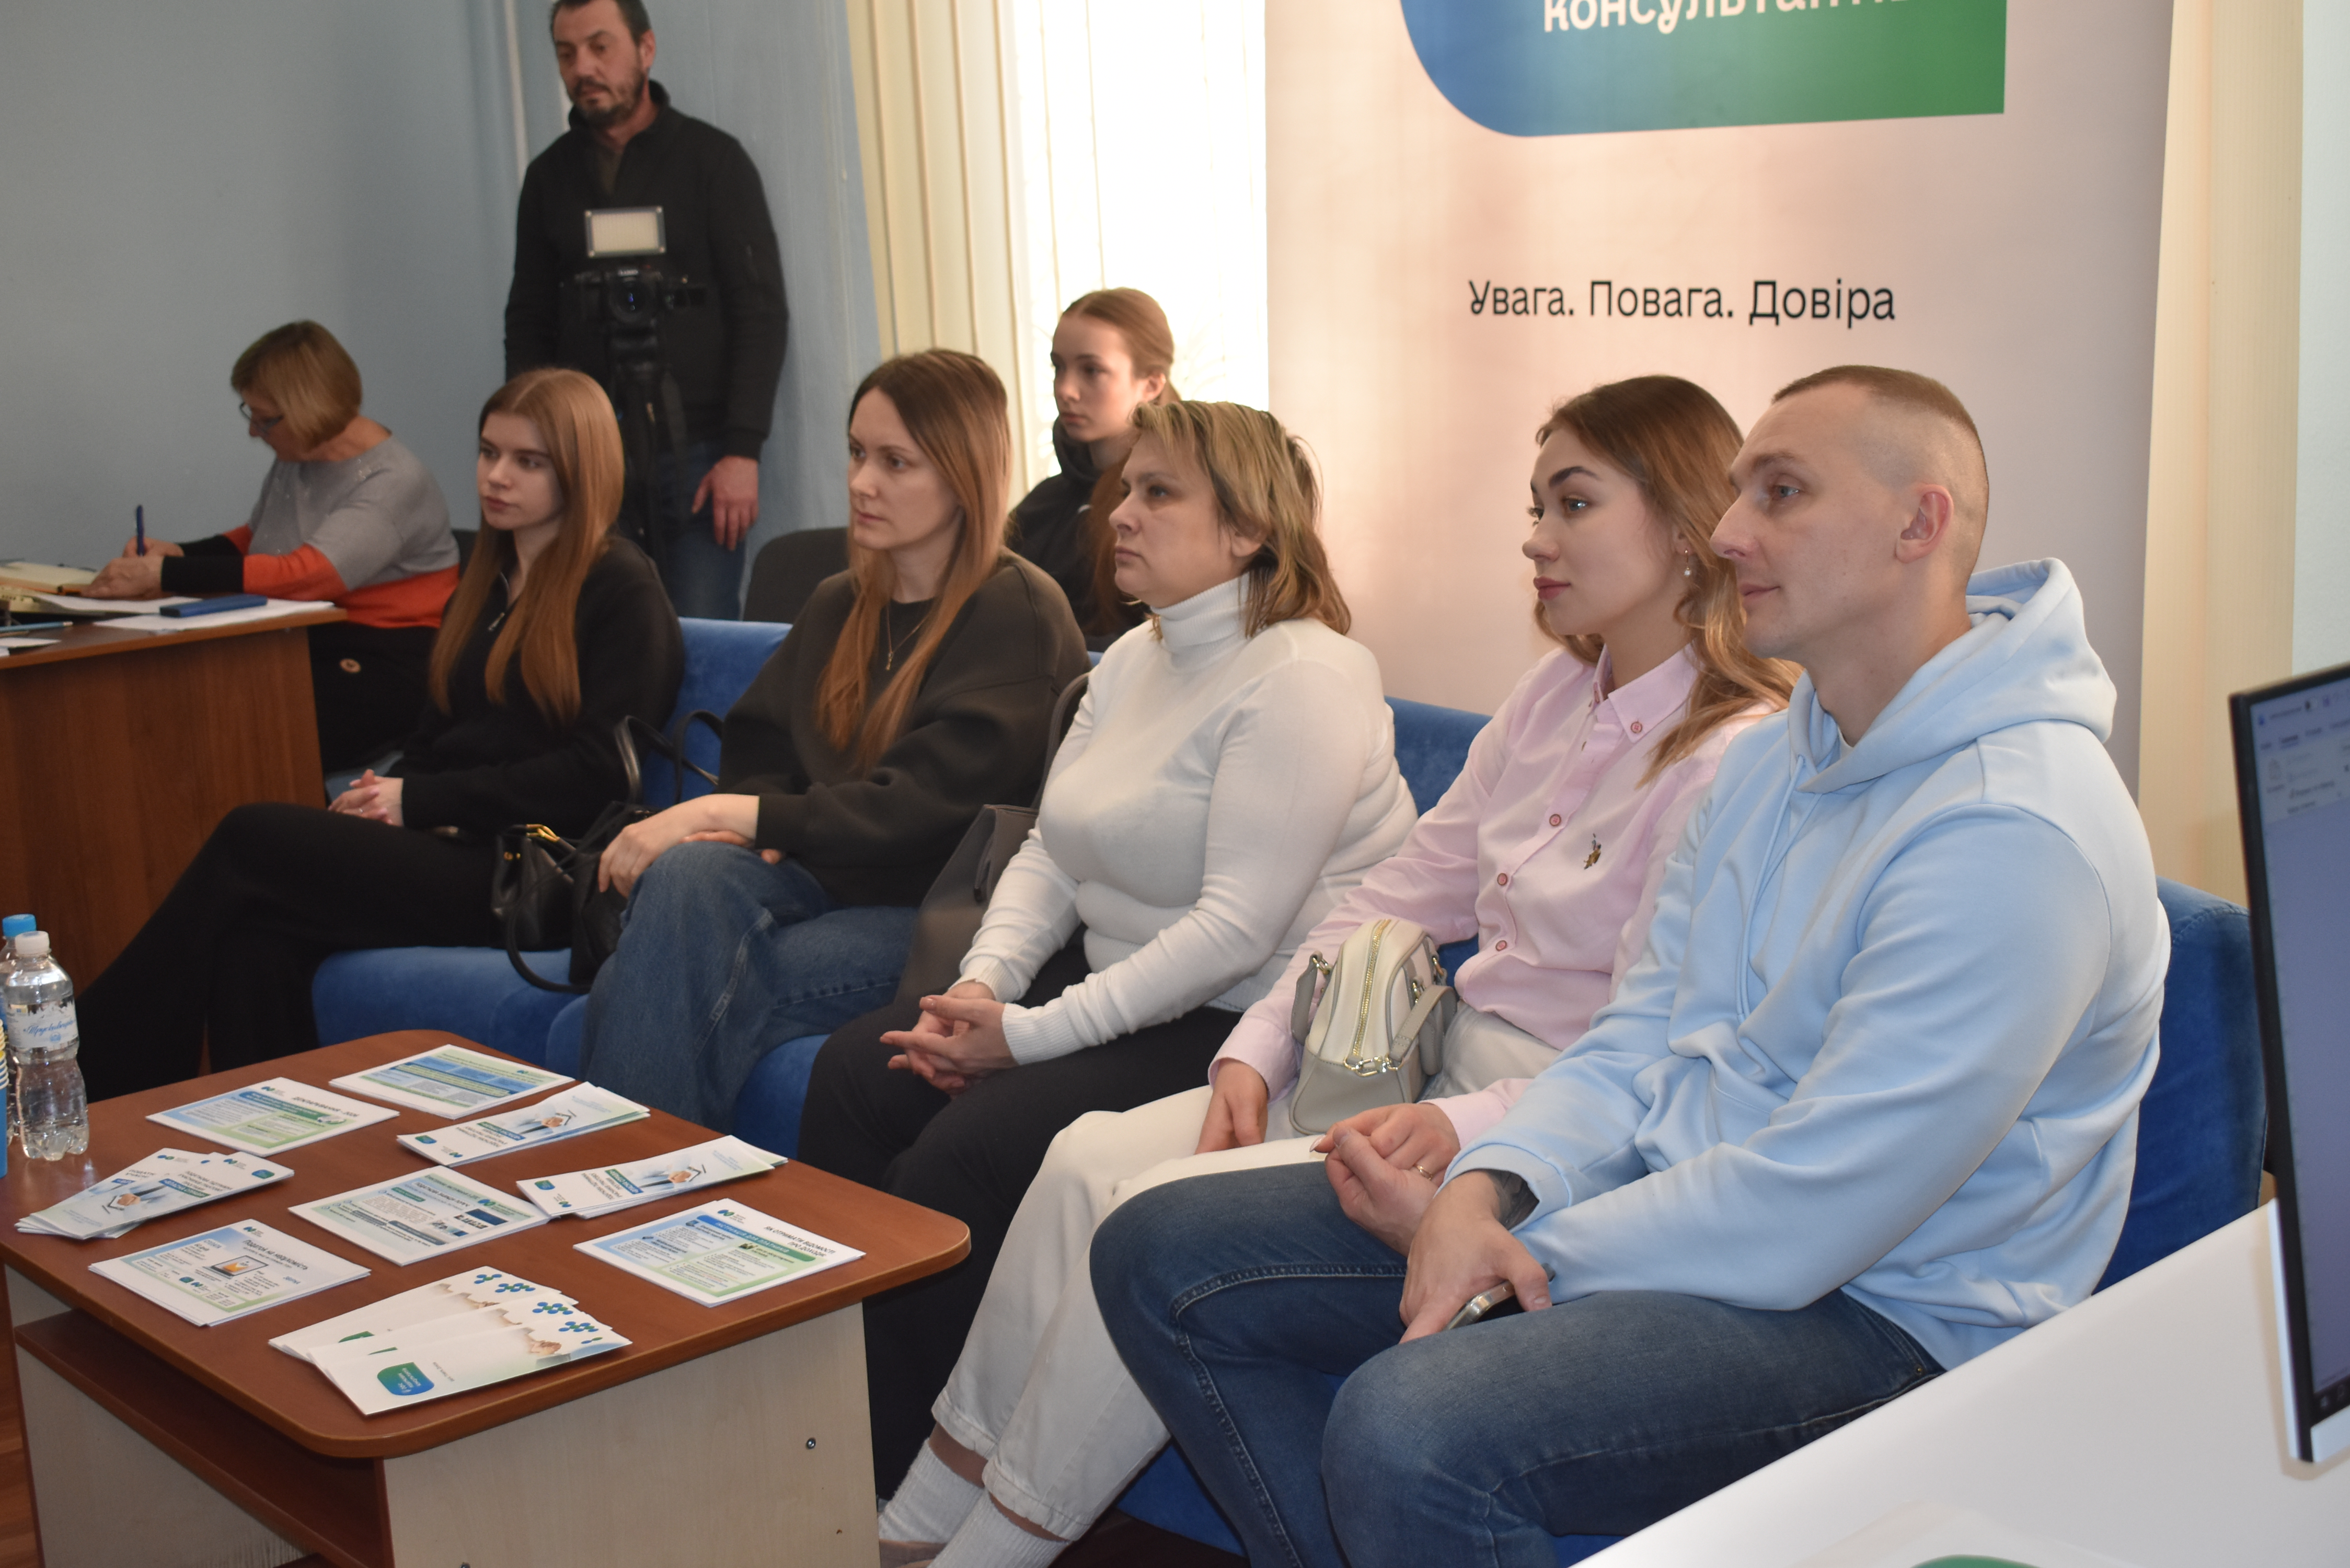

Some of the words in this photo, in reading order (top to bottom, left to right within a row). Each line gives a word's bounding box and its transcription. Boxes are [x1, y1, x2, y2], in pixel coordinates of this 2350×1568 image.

[1469, 280, 1574, 316] Увага.
[1590, 280, 1734, 318] Повага.
[1749, 279, 1895, 329] Довіра
